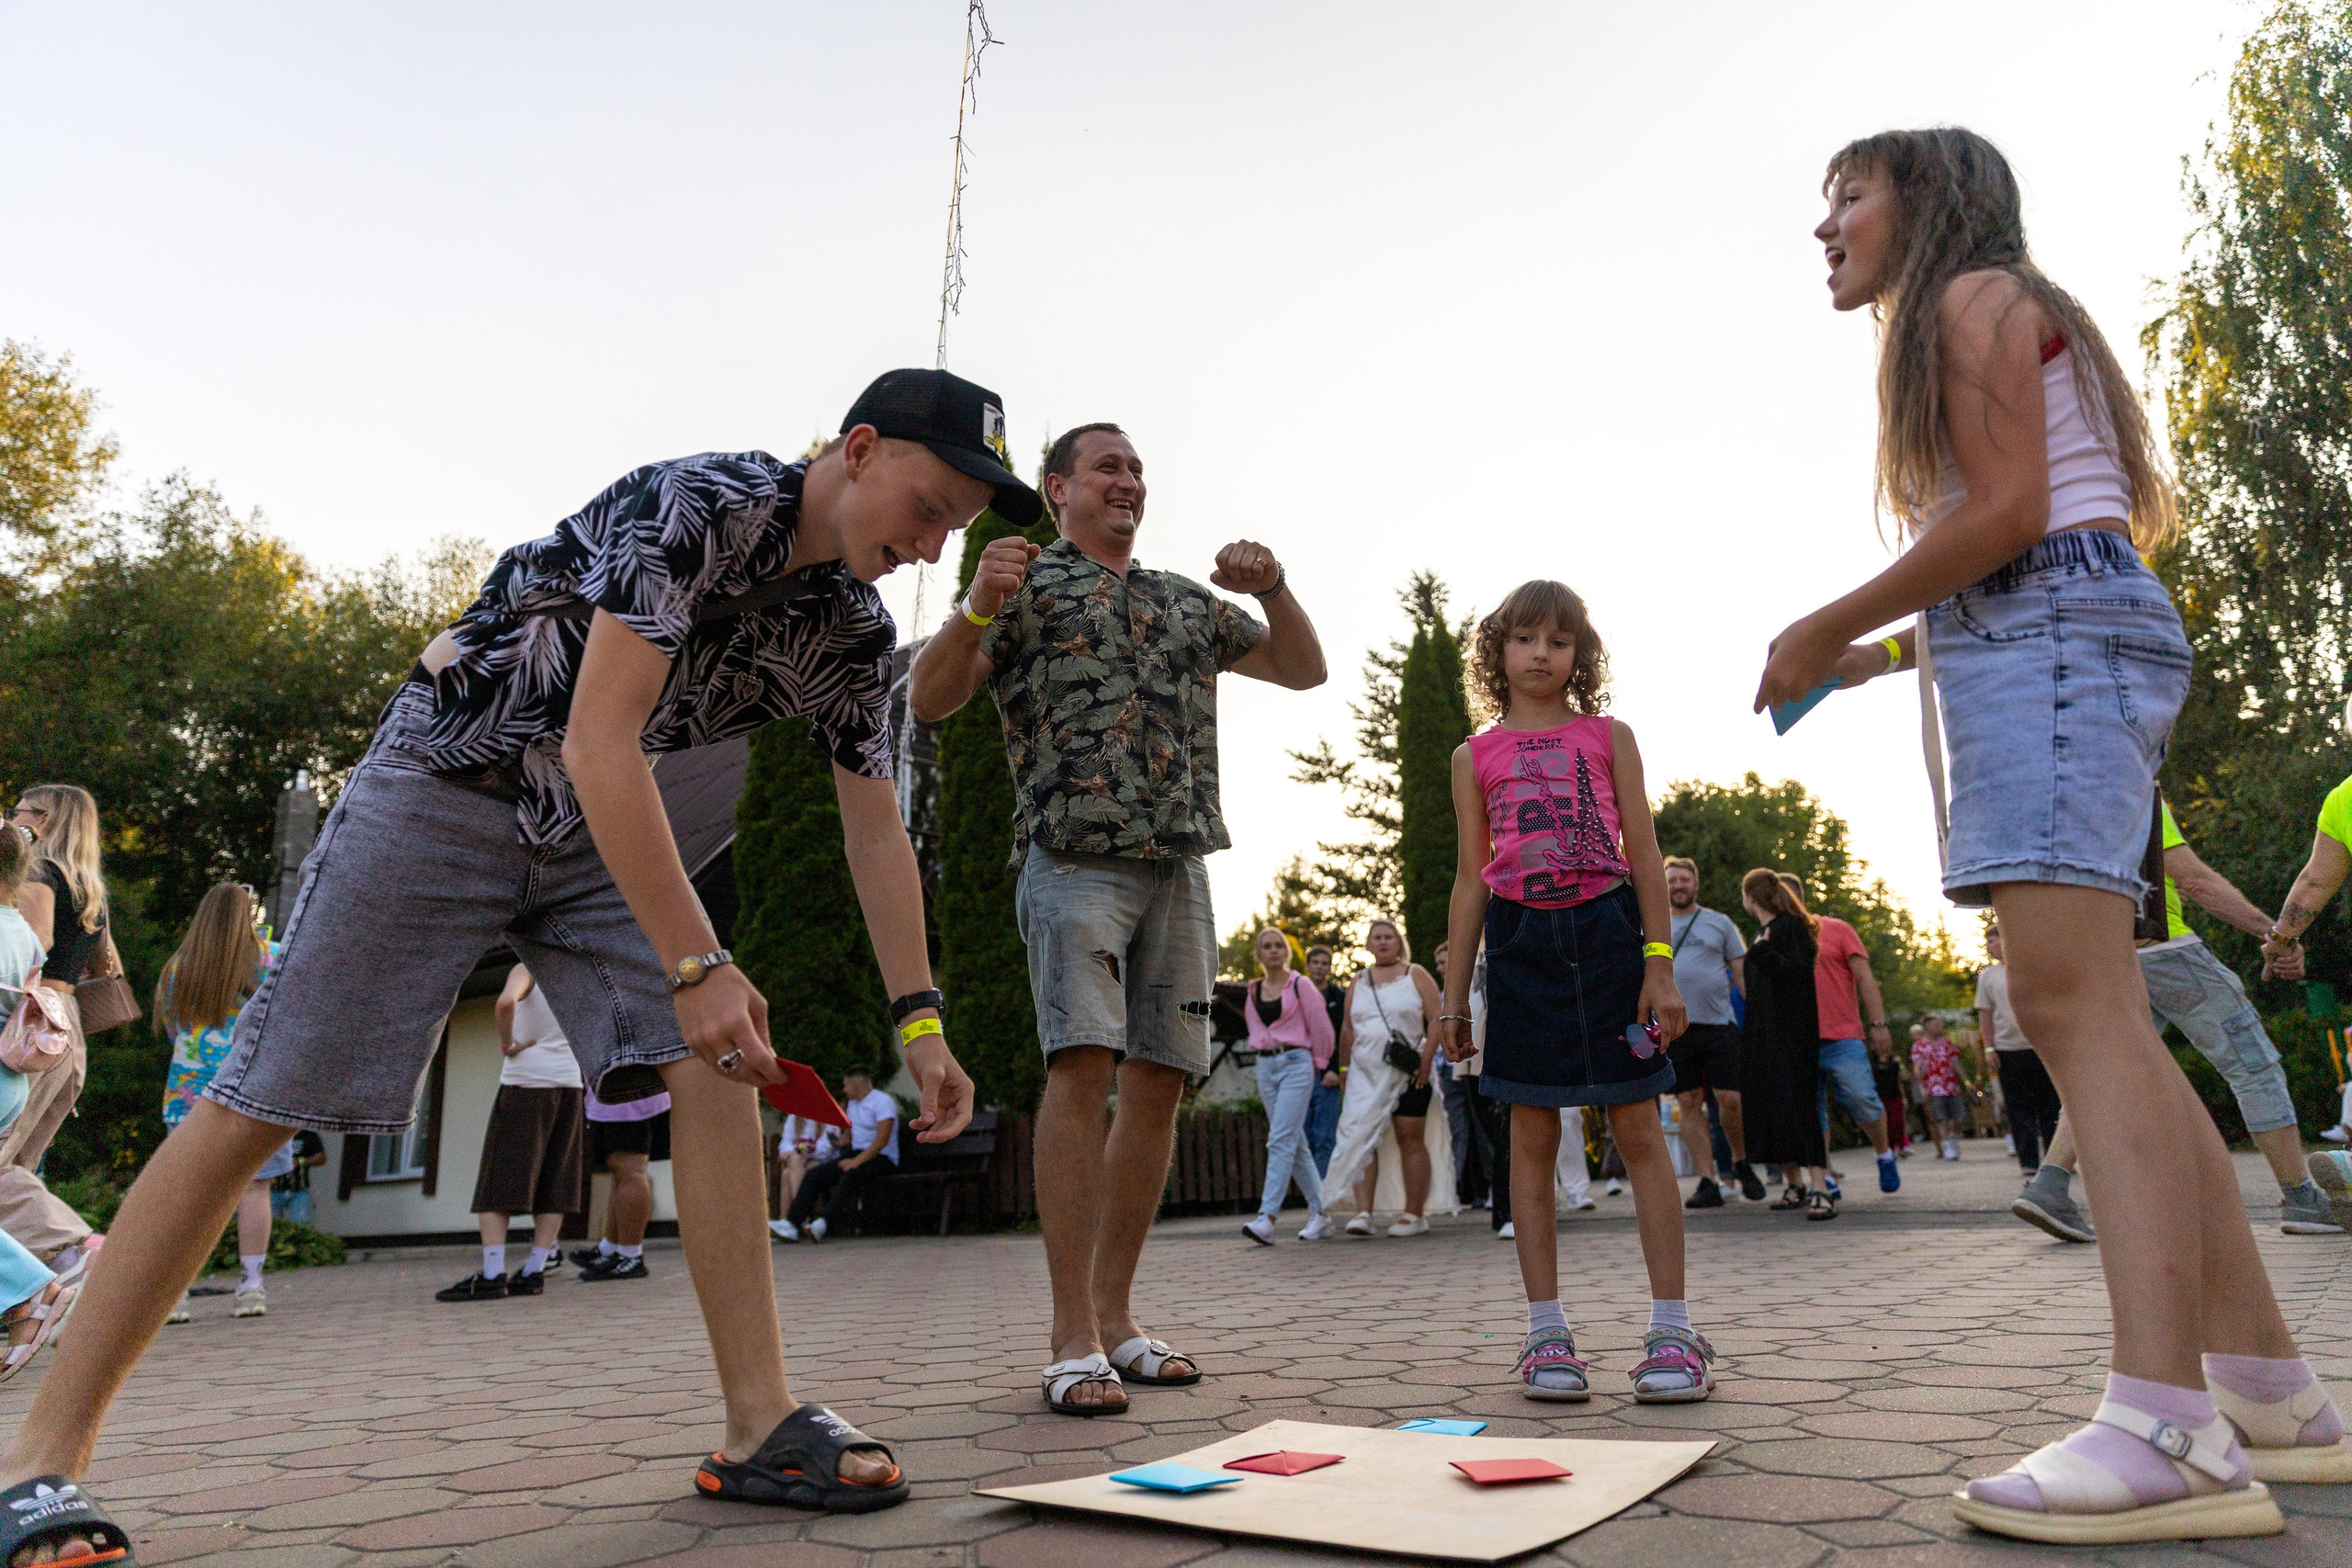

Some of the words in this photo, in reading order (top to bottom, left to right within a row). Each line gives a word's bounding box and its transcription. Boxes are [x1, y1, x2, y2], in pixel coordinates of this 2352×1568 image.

[1517, 739, 1535, 749] THE
[1511, 750, 1582, 901] PARIS
[829, 1426, 862, 1437] adid
[18, 1500, 88, 1526] adidas
